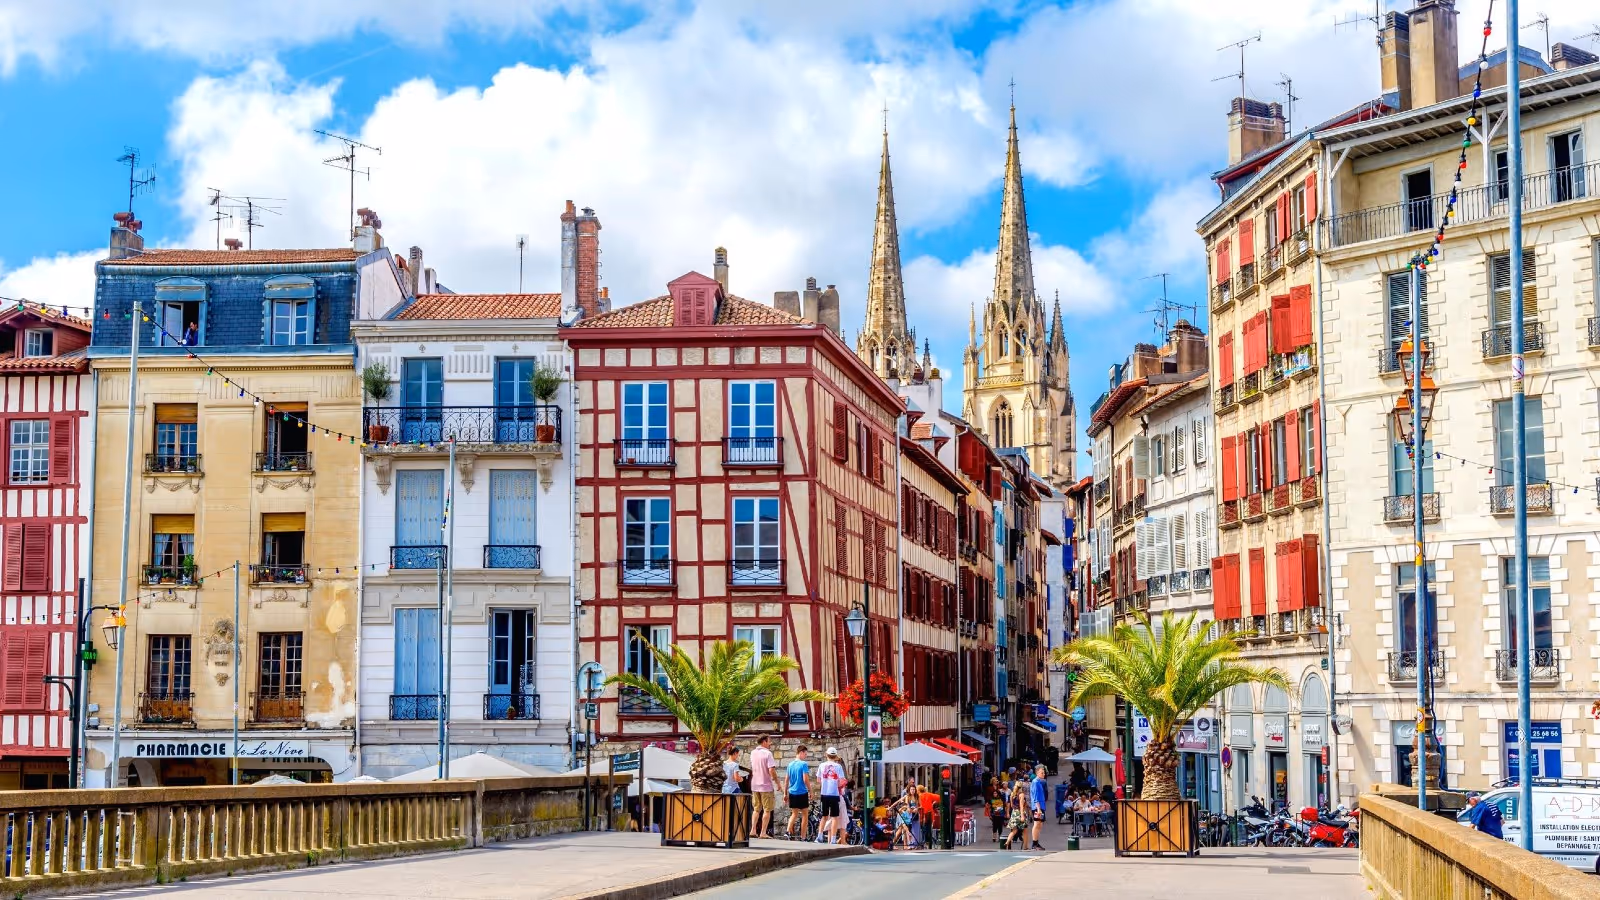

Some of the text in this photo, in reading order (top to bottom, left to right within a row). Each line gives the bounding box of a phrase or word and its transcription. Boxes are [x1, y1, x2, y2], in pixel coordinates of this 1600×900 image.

[136, 743, 226, 756] PHARMACIE
[247, 741, 267, 756] La
[267, 741, 304, 756] Nive
